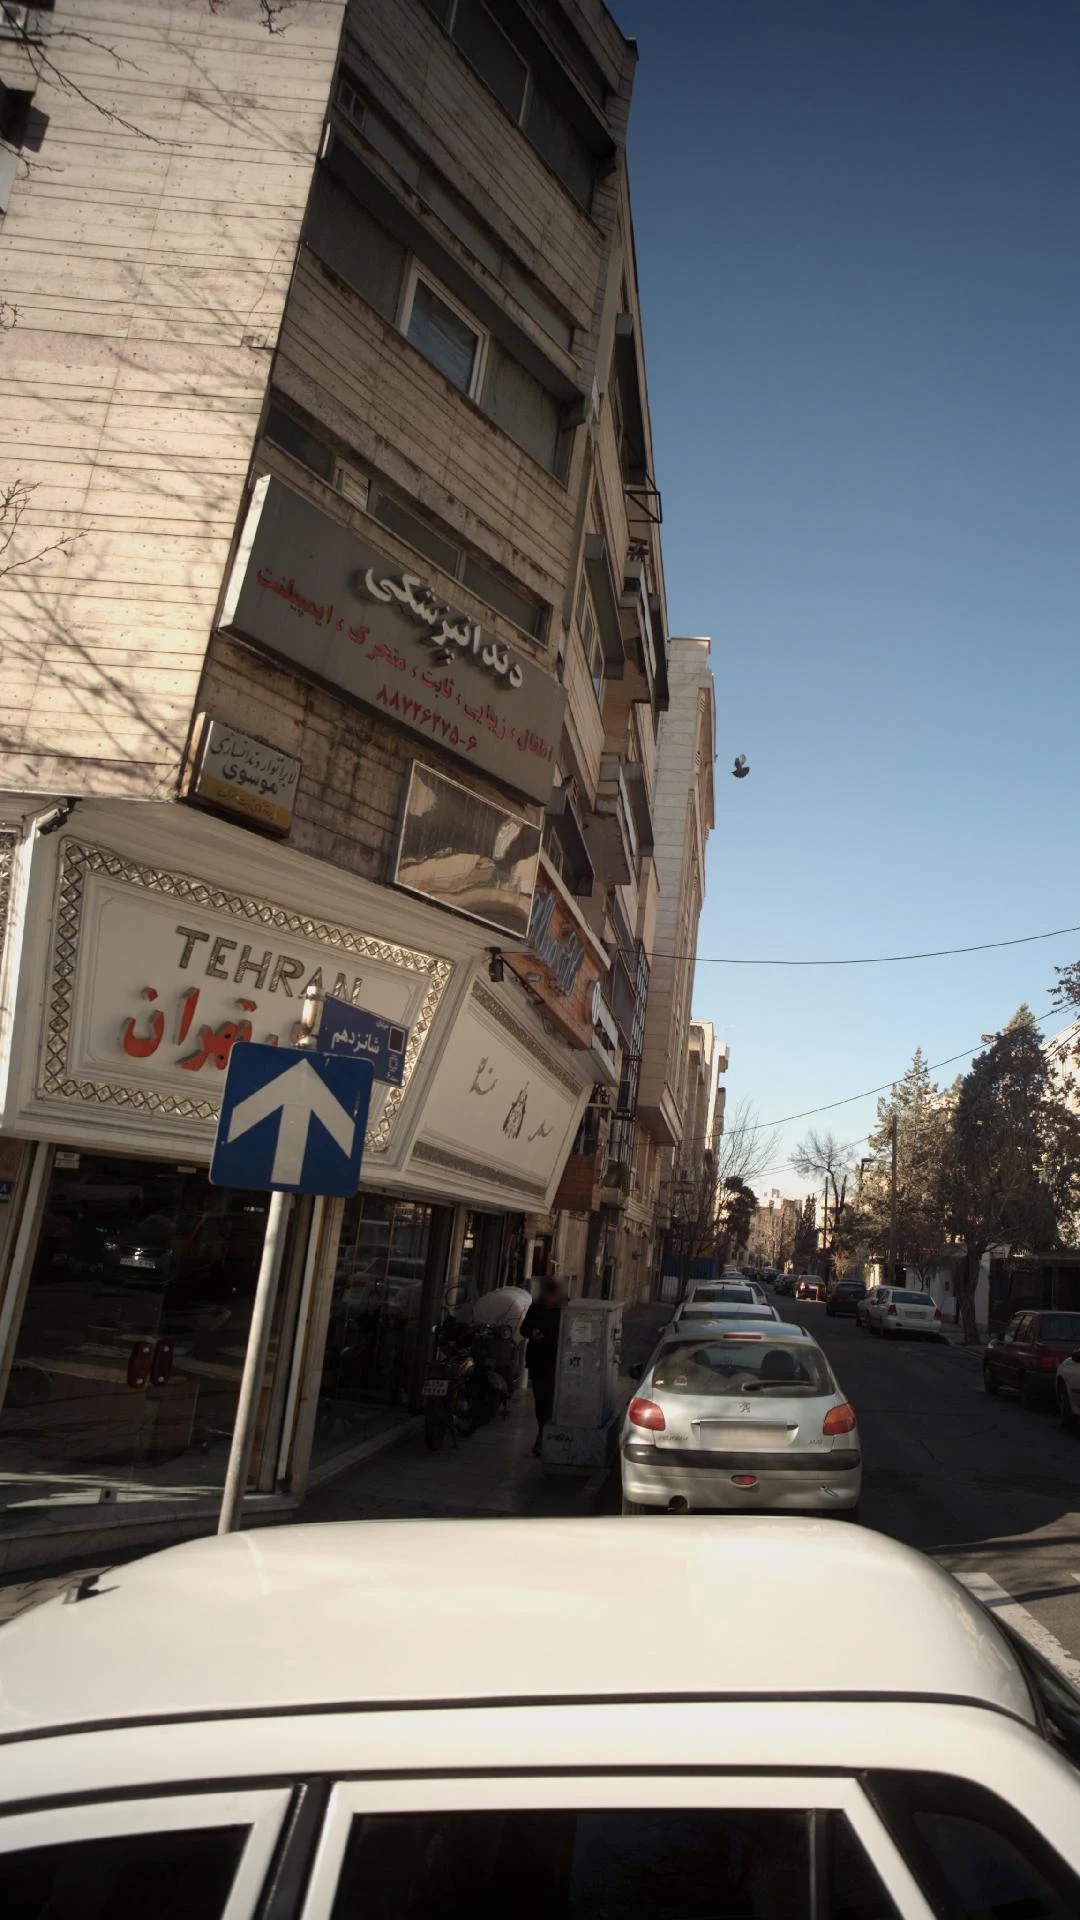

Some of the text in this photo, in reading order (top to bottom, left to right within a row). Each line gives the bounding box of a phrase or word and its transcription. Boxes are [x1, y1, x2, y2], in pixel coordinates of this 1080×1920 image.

[365, 568, 523, 688] دندانپزشکی
[223, 764, 278, 795] موسوی
[176, 926, 363, 1005] TEHRAN
[331, 1028, 380, 1054] شانزدهم
